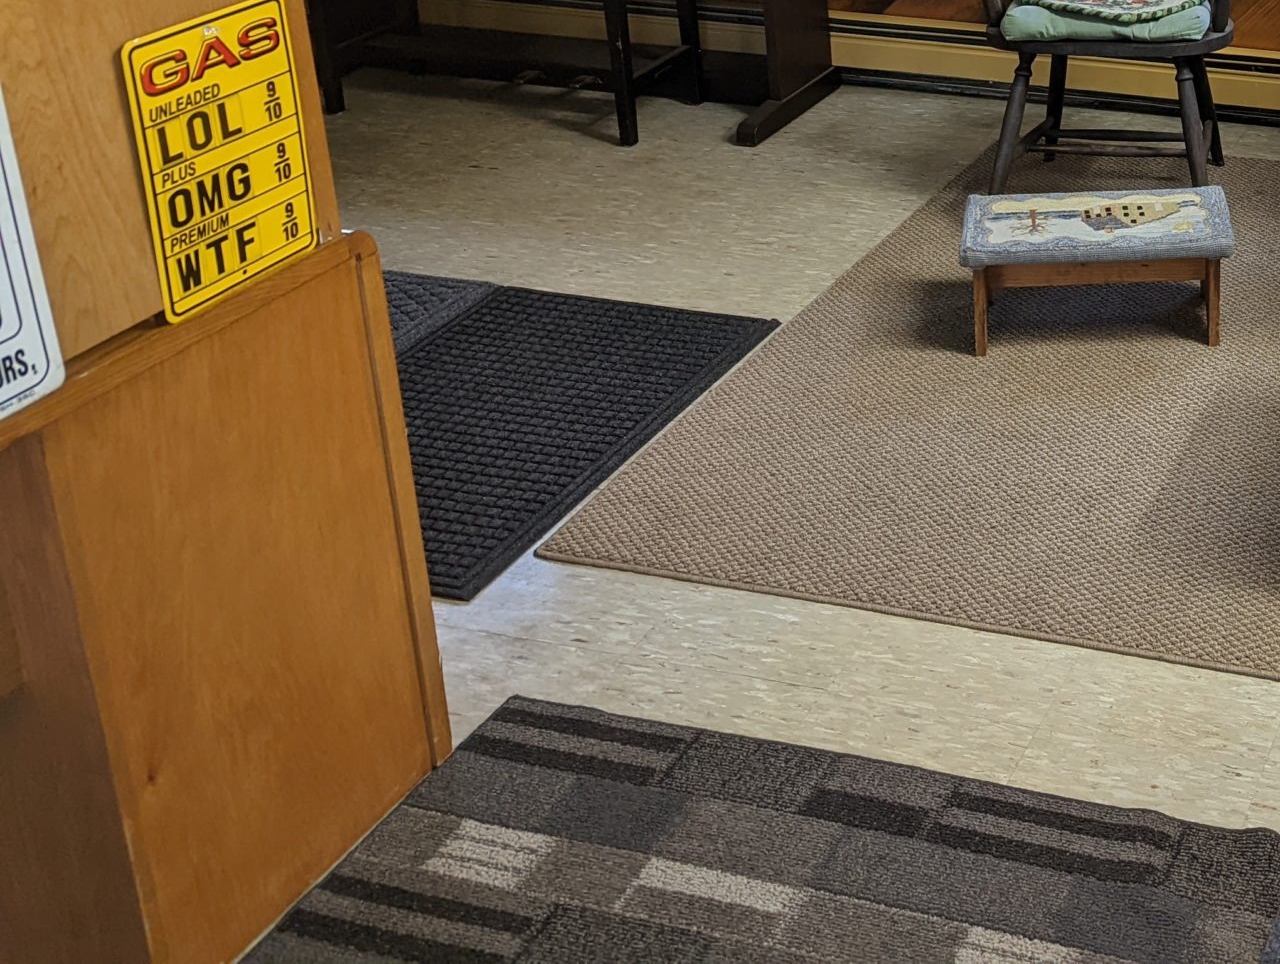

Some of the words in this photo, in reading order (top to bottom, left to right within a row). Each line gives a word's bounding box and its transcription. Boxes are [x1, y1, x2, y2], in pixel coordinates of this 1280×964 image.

[139, 16, 281, 98] GAS
[149, 83, 221, 123] UNLEADED
[265, 80, 277, 98] 9
[264, 102, 283, 123] 10
[156, 102, 243, 166] LOL
[276, 142, 287, 159] 9
[161, 161, 197, 189] PLUS
[274, 162, 292, 183] 10
[167, 162, 252, 229] OMG
[284, 201, 295, 219] 9
[170, 212, 230, 254] PREMIUM
[282, 221, 299, 242] 10
[176, 221, 257, 294] WTF
